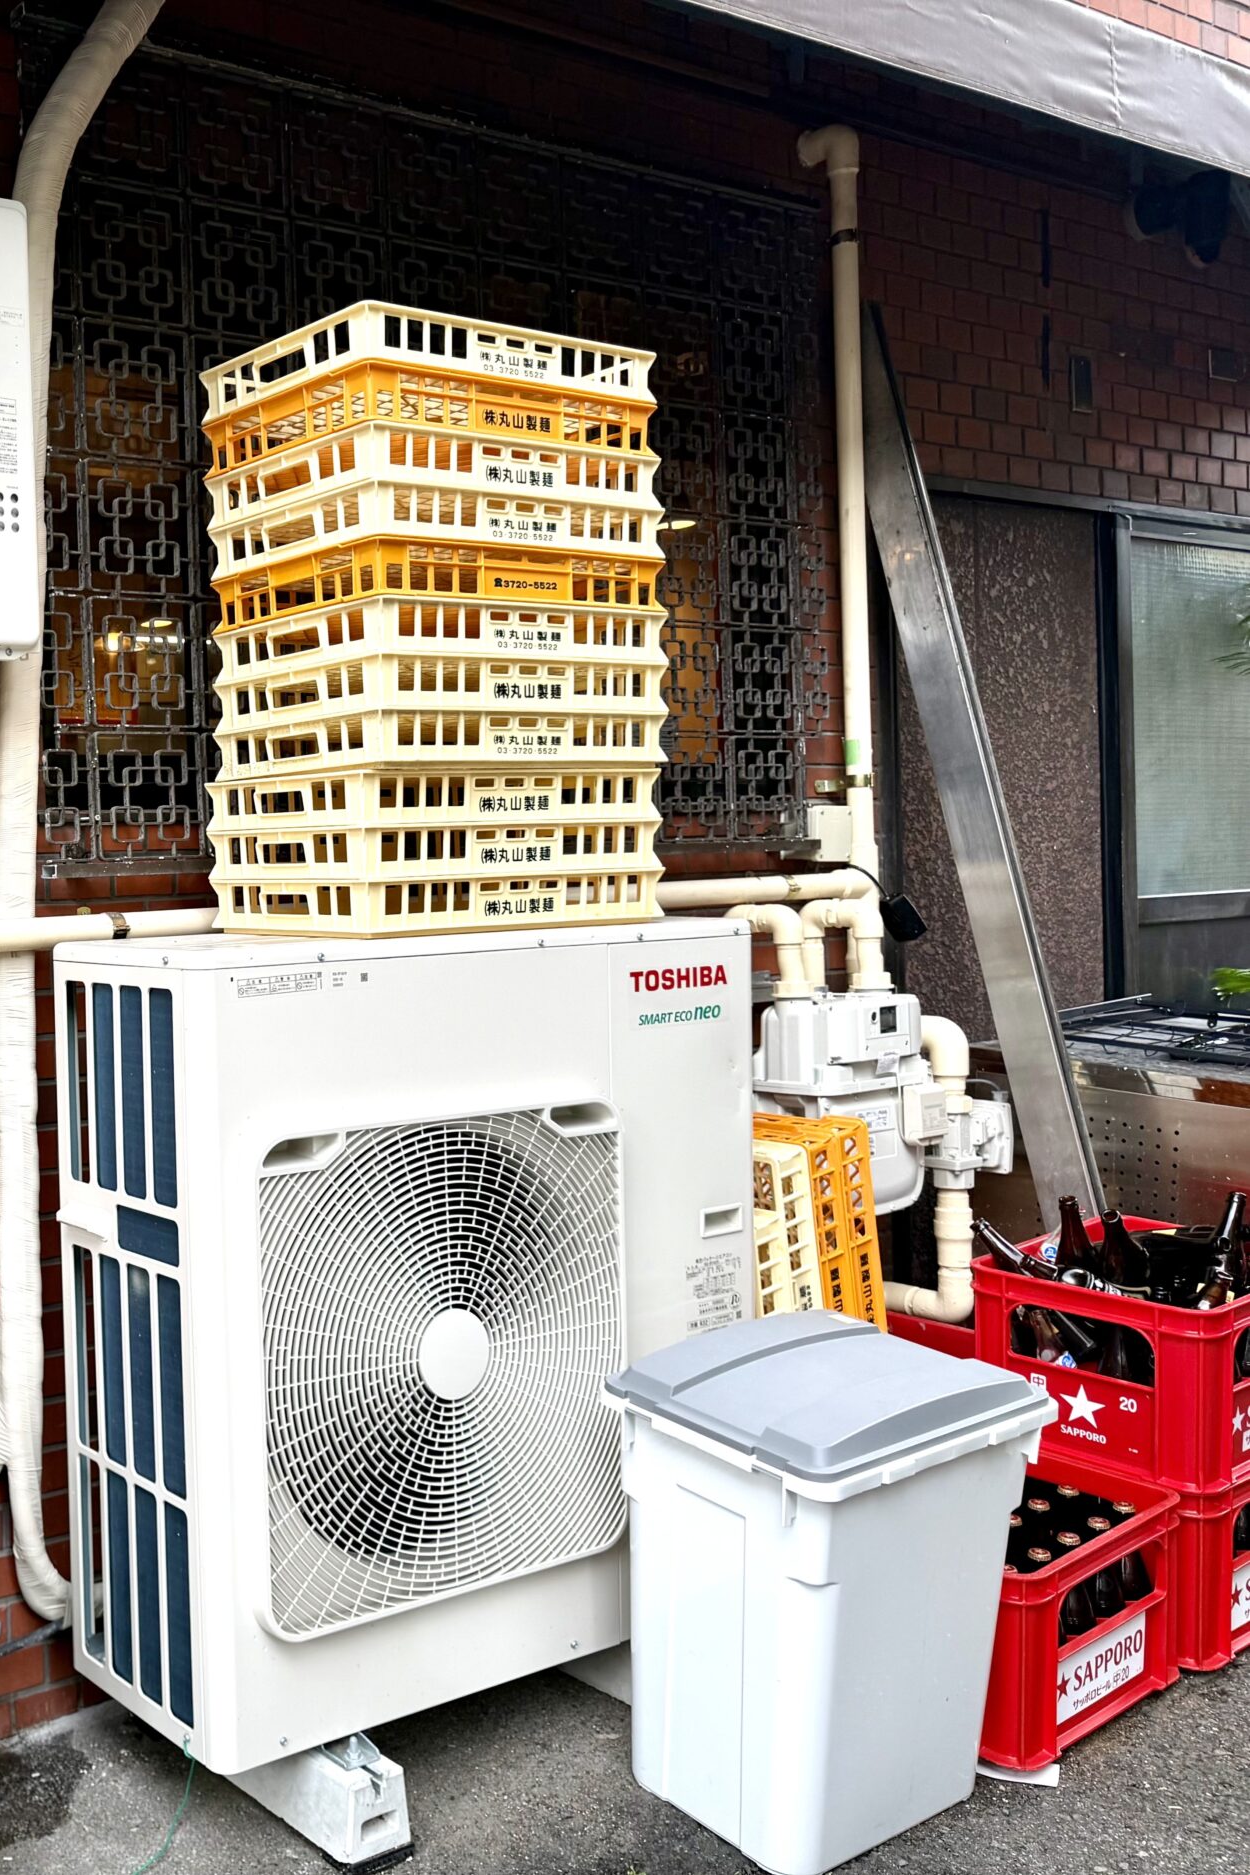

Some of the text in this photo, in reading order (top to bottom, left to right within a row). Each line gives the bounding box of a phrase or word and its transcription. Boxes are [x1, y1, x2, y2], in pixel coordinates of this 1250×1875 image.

[629, 965, 727, 992] TOSHIBA
[638, 1004, 721, 1026] SMART ECO neo
[1119, 1397, 1138, 1413] 20
[1060, 1423, 1107, 1445] SAPPORO
[1073, 1629, 1143, 1691] SAPPORO
